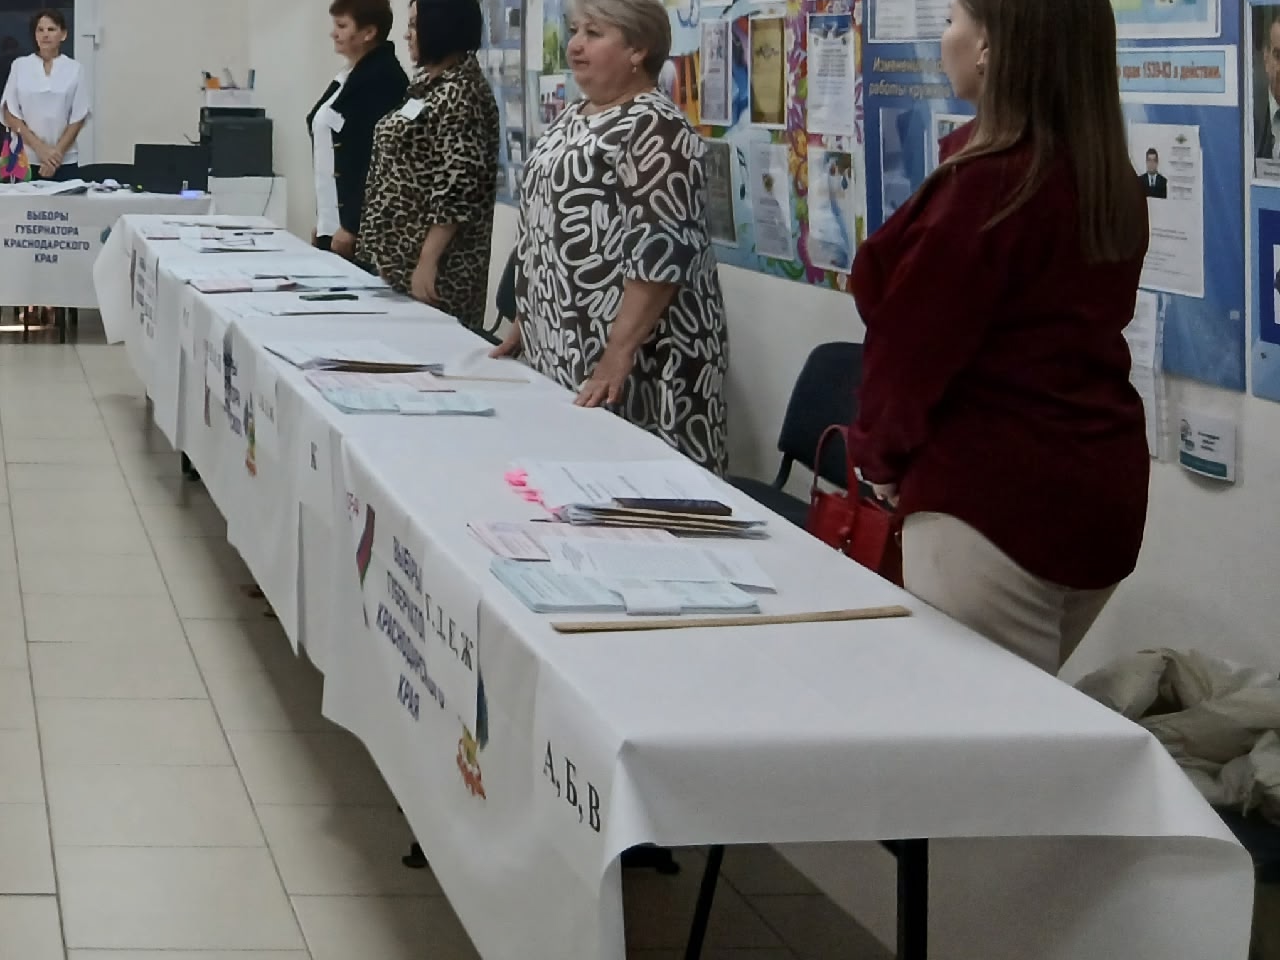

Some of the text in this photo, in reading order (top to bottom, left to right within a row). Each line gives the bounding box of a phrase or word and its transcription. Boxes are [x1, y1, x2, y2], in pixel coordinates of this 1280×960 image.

[26, 210, 69, 222] ВЫБОРЫ
[15, 224, 79, 236] ГУБЕРНАТОРА
[3, 238, 90, 251] КРАСНОДАРСКОГО
[34, 253, 59, 264] КРАЯ
